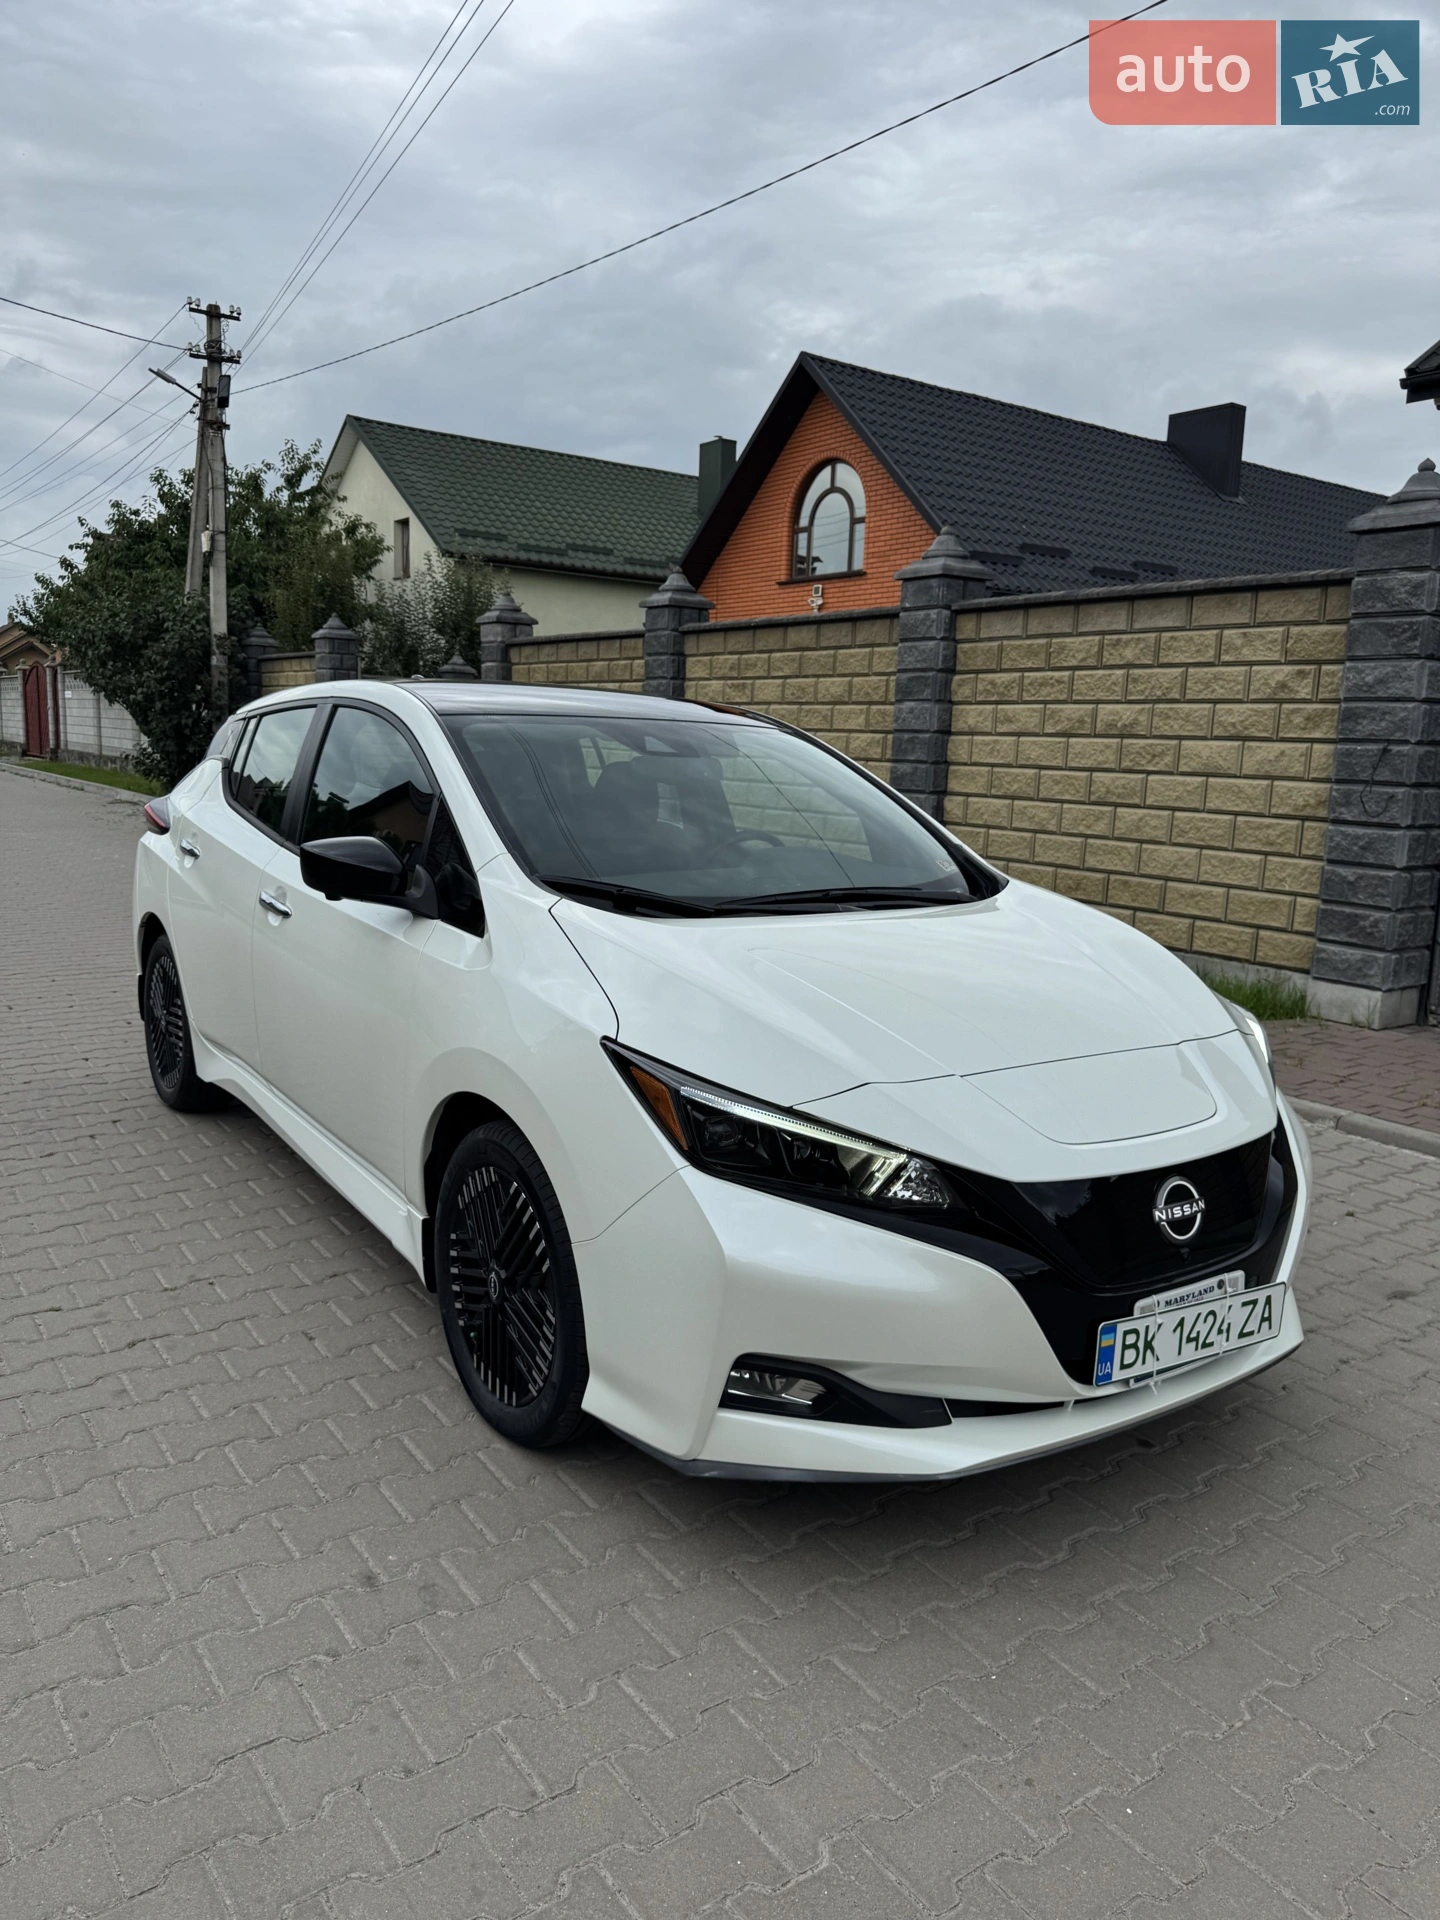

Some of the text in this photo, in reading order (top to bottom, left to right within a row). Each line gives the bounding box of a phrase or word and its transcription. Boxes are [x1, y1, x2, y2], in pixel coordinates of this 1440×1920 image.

[1154, 1199, 1205, 1221] NISSAN
[1164, 1285, 1215, 1307] MARYLAND
[1119, 1294, 1273, 1371] BK 1424 ZA
[1098, 1363, 1112, 1376] UA
